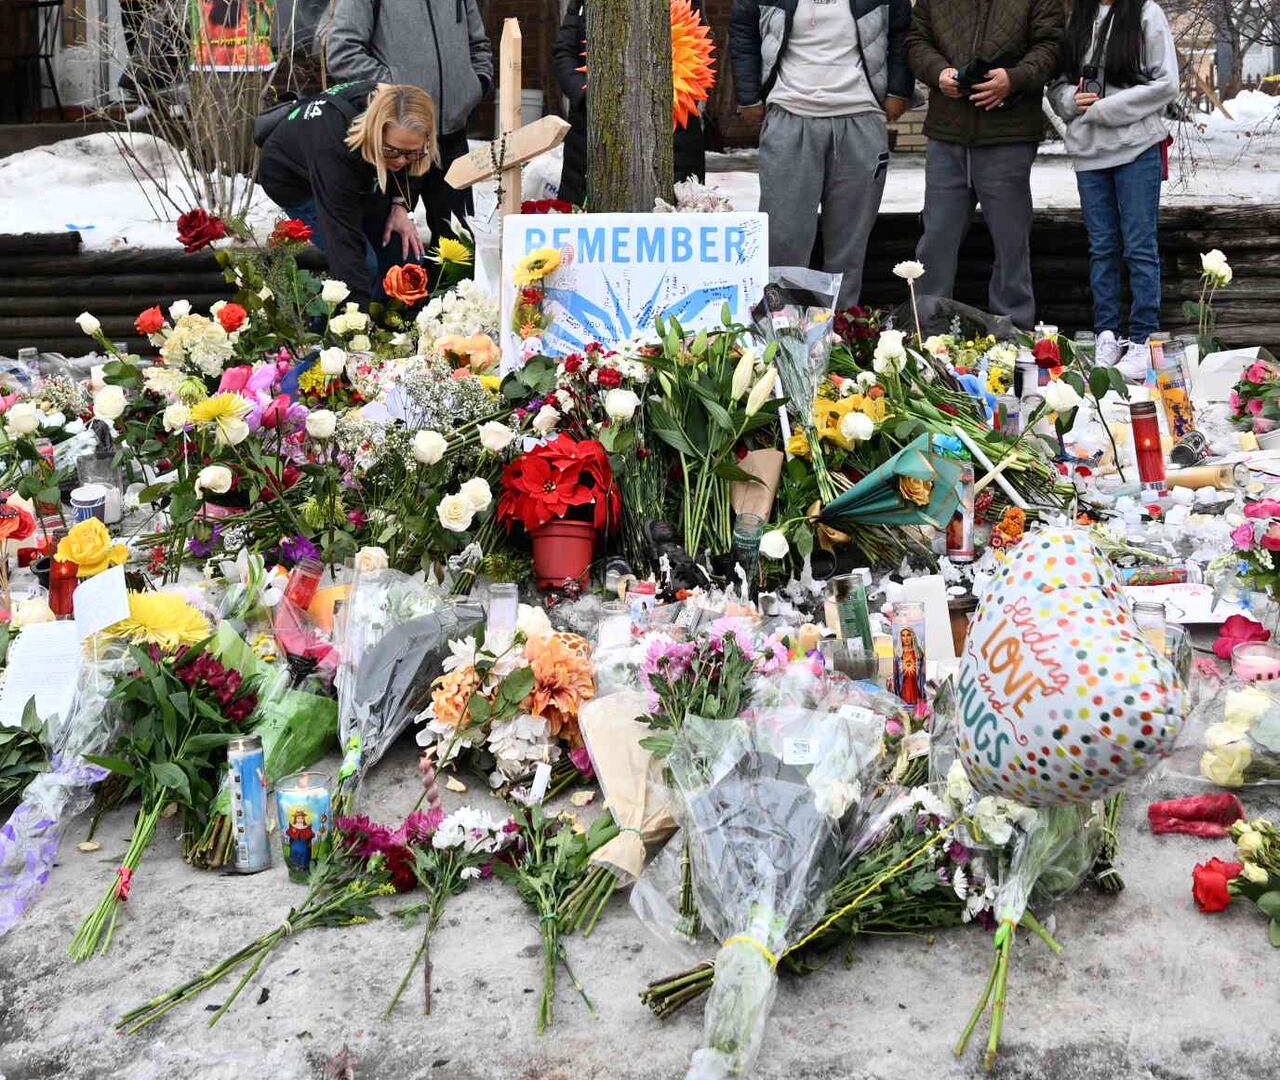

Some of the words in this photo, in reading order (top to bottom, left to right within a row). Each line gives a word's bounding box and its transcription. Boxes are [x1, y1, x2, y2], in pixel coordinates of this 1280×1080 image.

[524, 226, 746, 264] REMEMBER
[977, 672, 1010, 715] and
[980, 618, 1048, 719] LOVE
[958, 663, 1010, 769] HUGS
